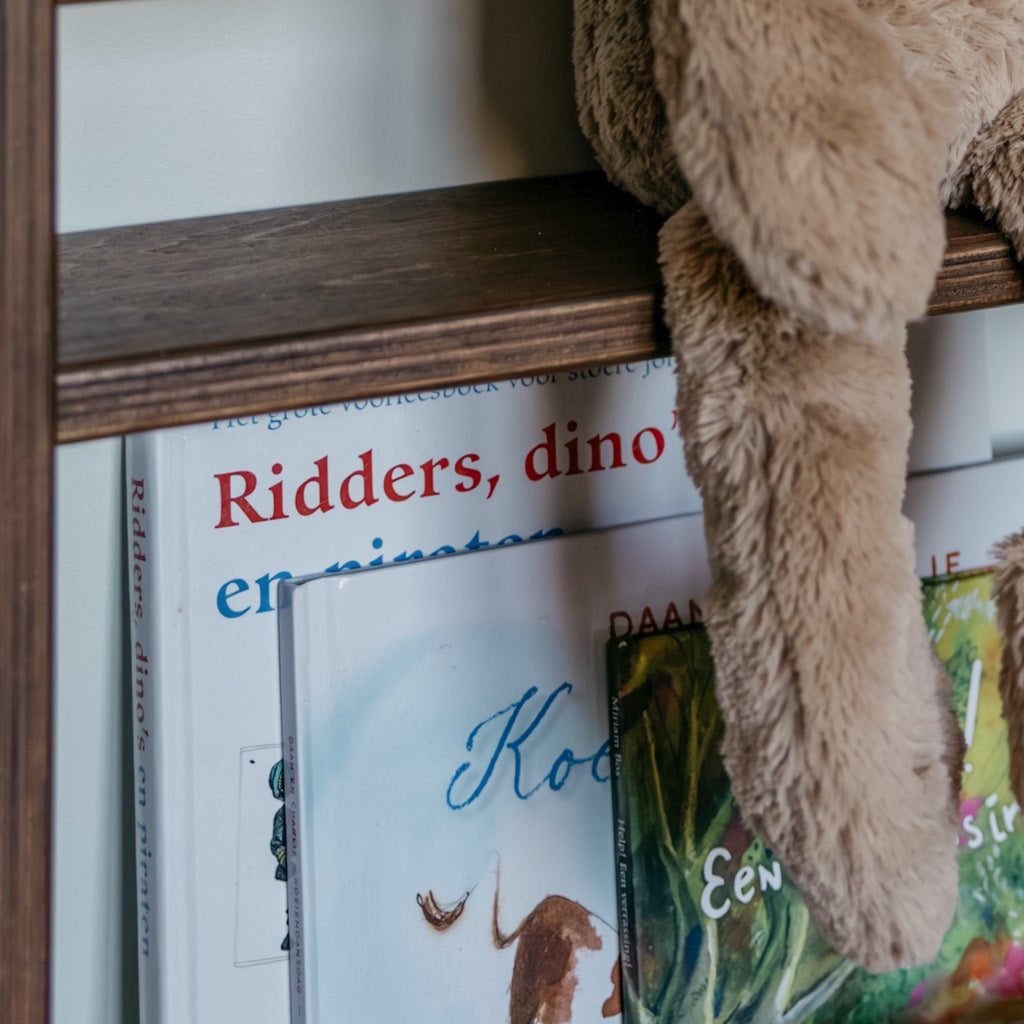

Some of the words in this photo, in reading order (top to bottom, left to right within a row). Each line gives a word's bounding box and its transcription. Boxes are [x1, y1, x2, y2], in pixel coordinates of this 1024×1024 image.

[213, 449, 501, 529] Ridders,
[130, 478, 147, 627] Ridders,
[134, 640, 149, 752] dino's
[137, 765, 148, 808] en
[137, 821, 152, 957] piraten
